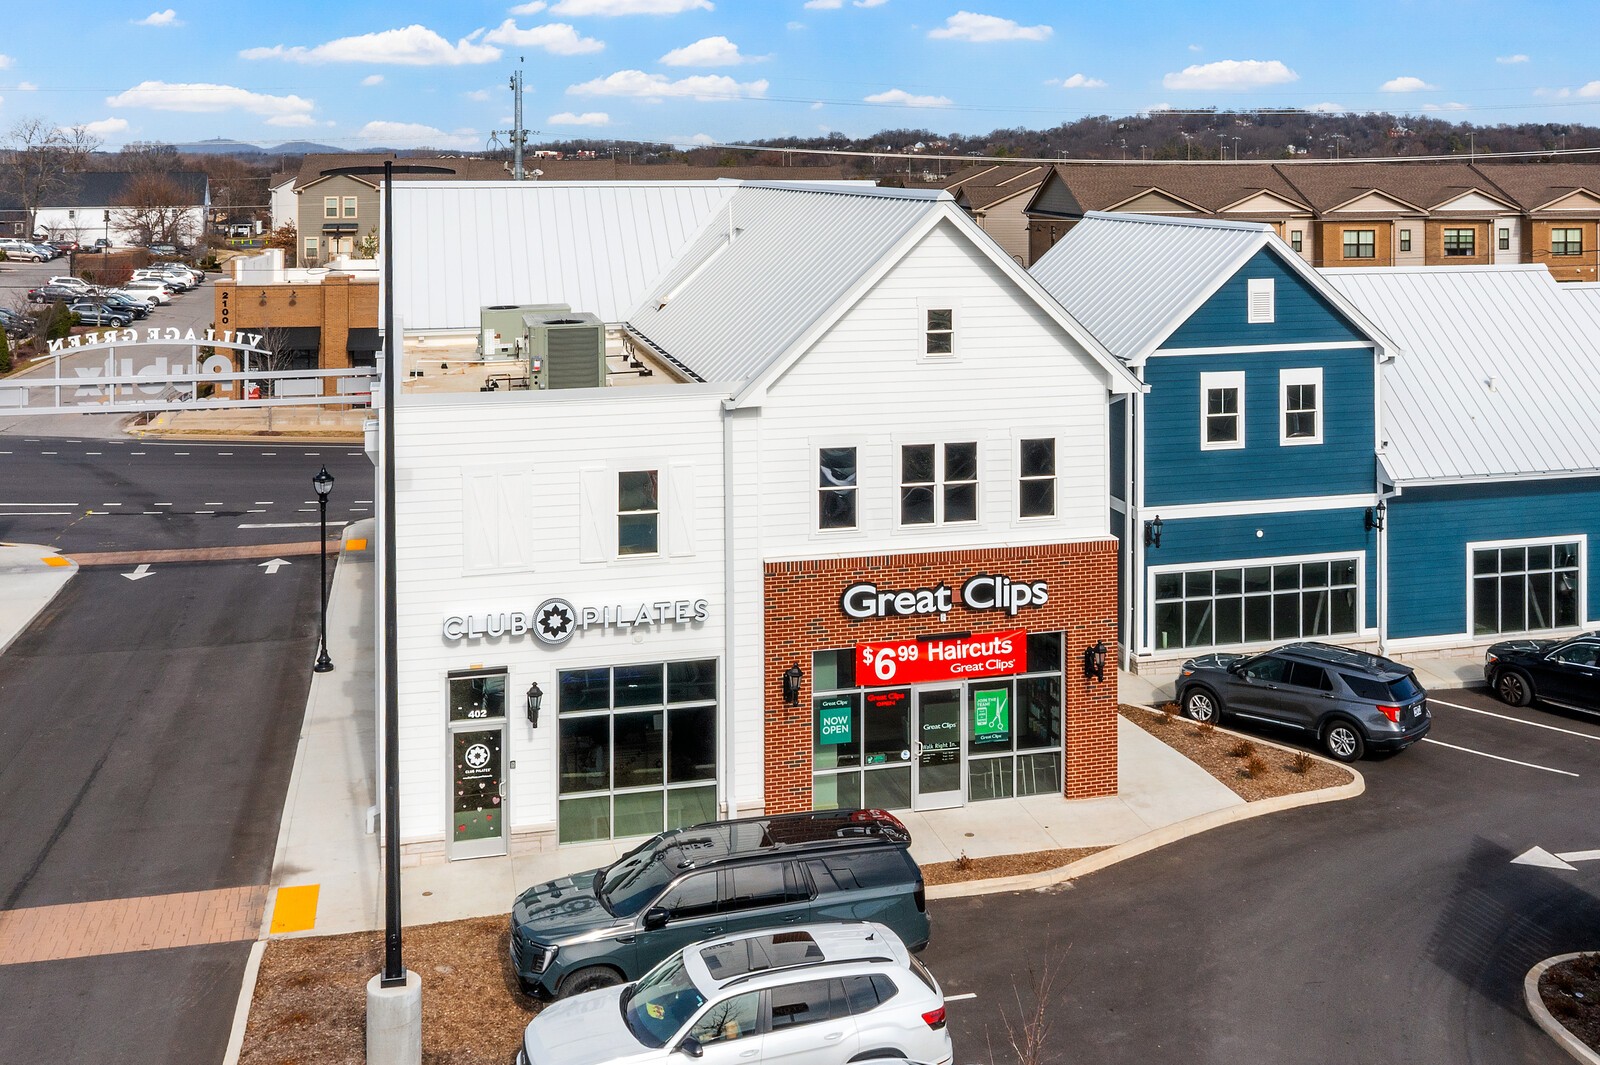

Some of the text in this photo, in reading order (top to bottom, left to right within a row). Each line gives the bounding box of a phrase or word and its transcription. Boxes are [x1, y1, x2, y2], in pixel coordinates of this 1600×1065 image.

[843, 577, 1048, 617] Great Clips
[443, 599, 709, 640] CLUB PILATES
[928, 637, 1013, 661] Haircuts
[950, 659, 1014, 673] Great Clips
[468, 709, 487, 718] 402
[823, 716, 848, 726] NOW
[822, 724, 849, 735] OPEN
